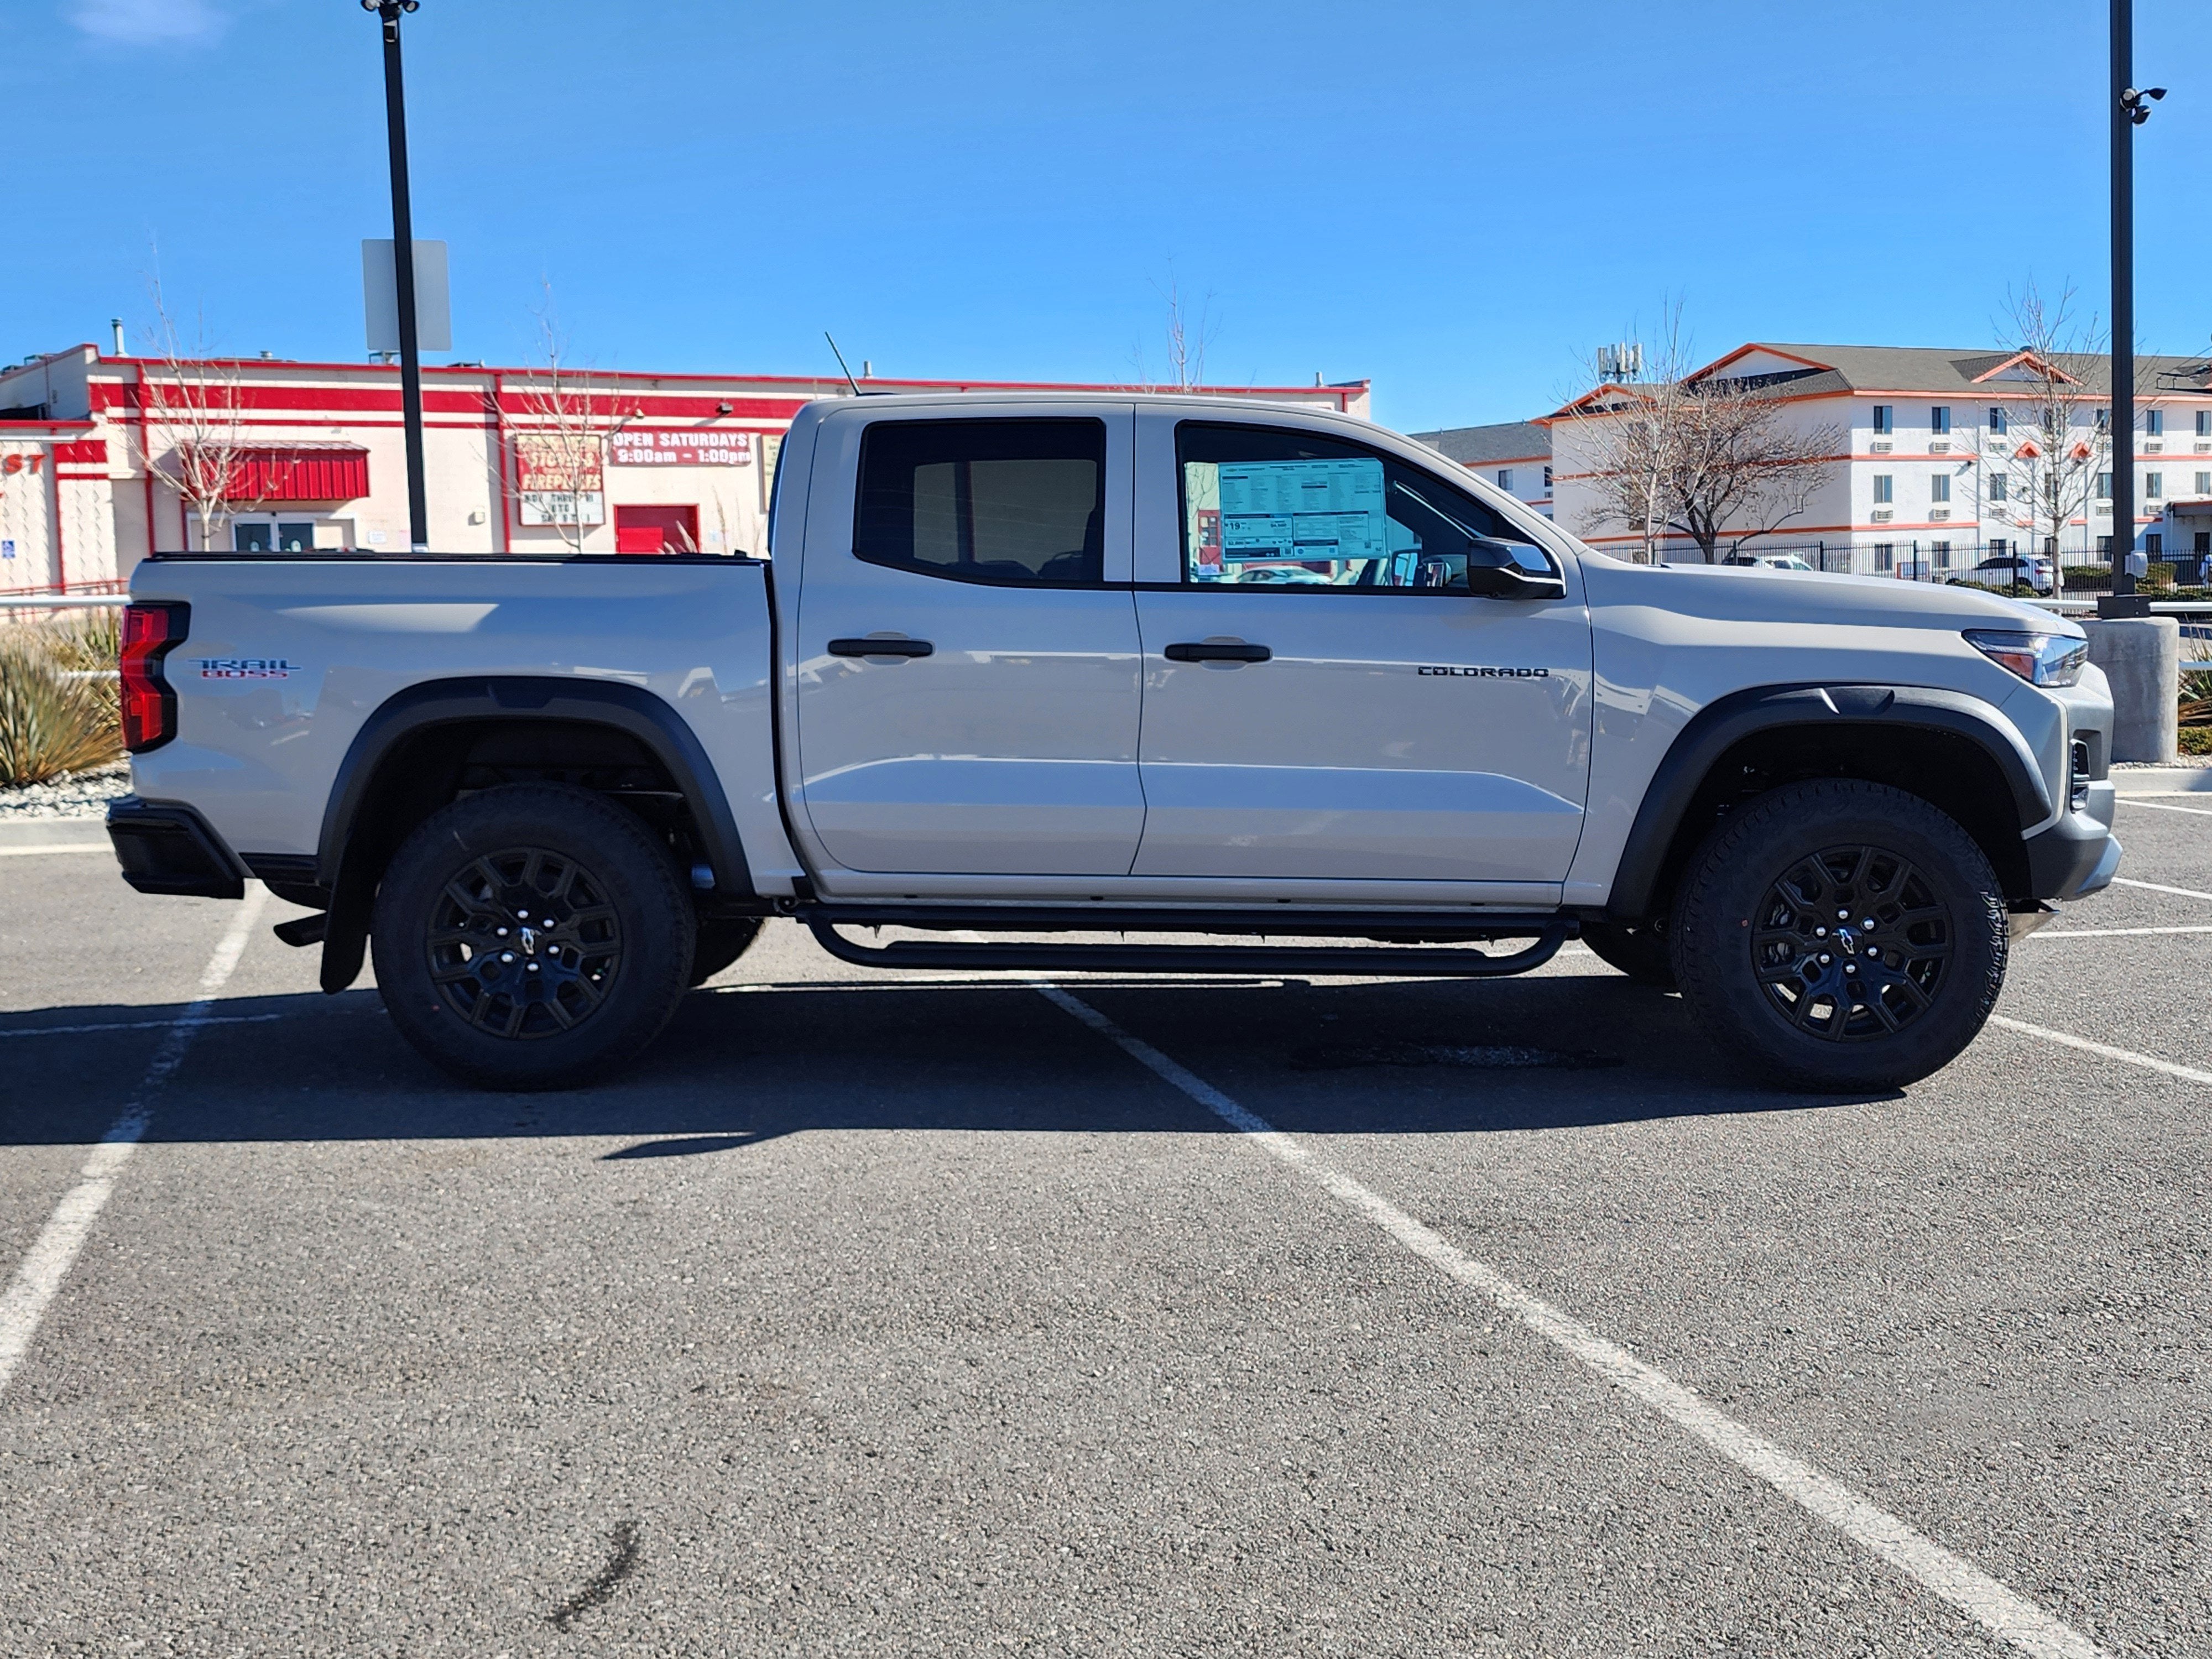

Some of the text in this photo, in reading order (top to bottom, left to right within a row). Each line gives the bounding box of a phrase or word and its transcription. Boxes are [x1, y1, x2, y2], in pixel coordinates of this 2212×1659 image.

[613, 432, 654, 446] OPEN
[659, 432, 748, 447] SATURDAYS
[0, 454, 46, 474] ST
[698, 449, 751, 465] 1:00pm
[522, 474, 601, 491] FIREPLES
[188, 659, 302, 670] TRAIL
[1418, 666, 1549, 677] COLORADO
[201, 670, 289, 679] BOSS
